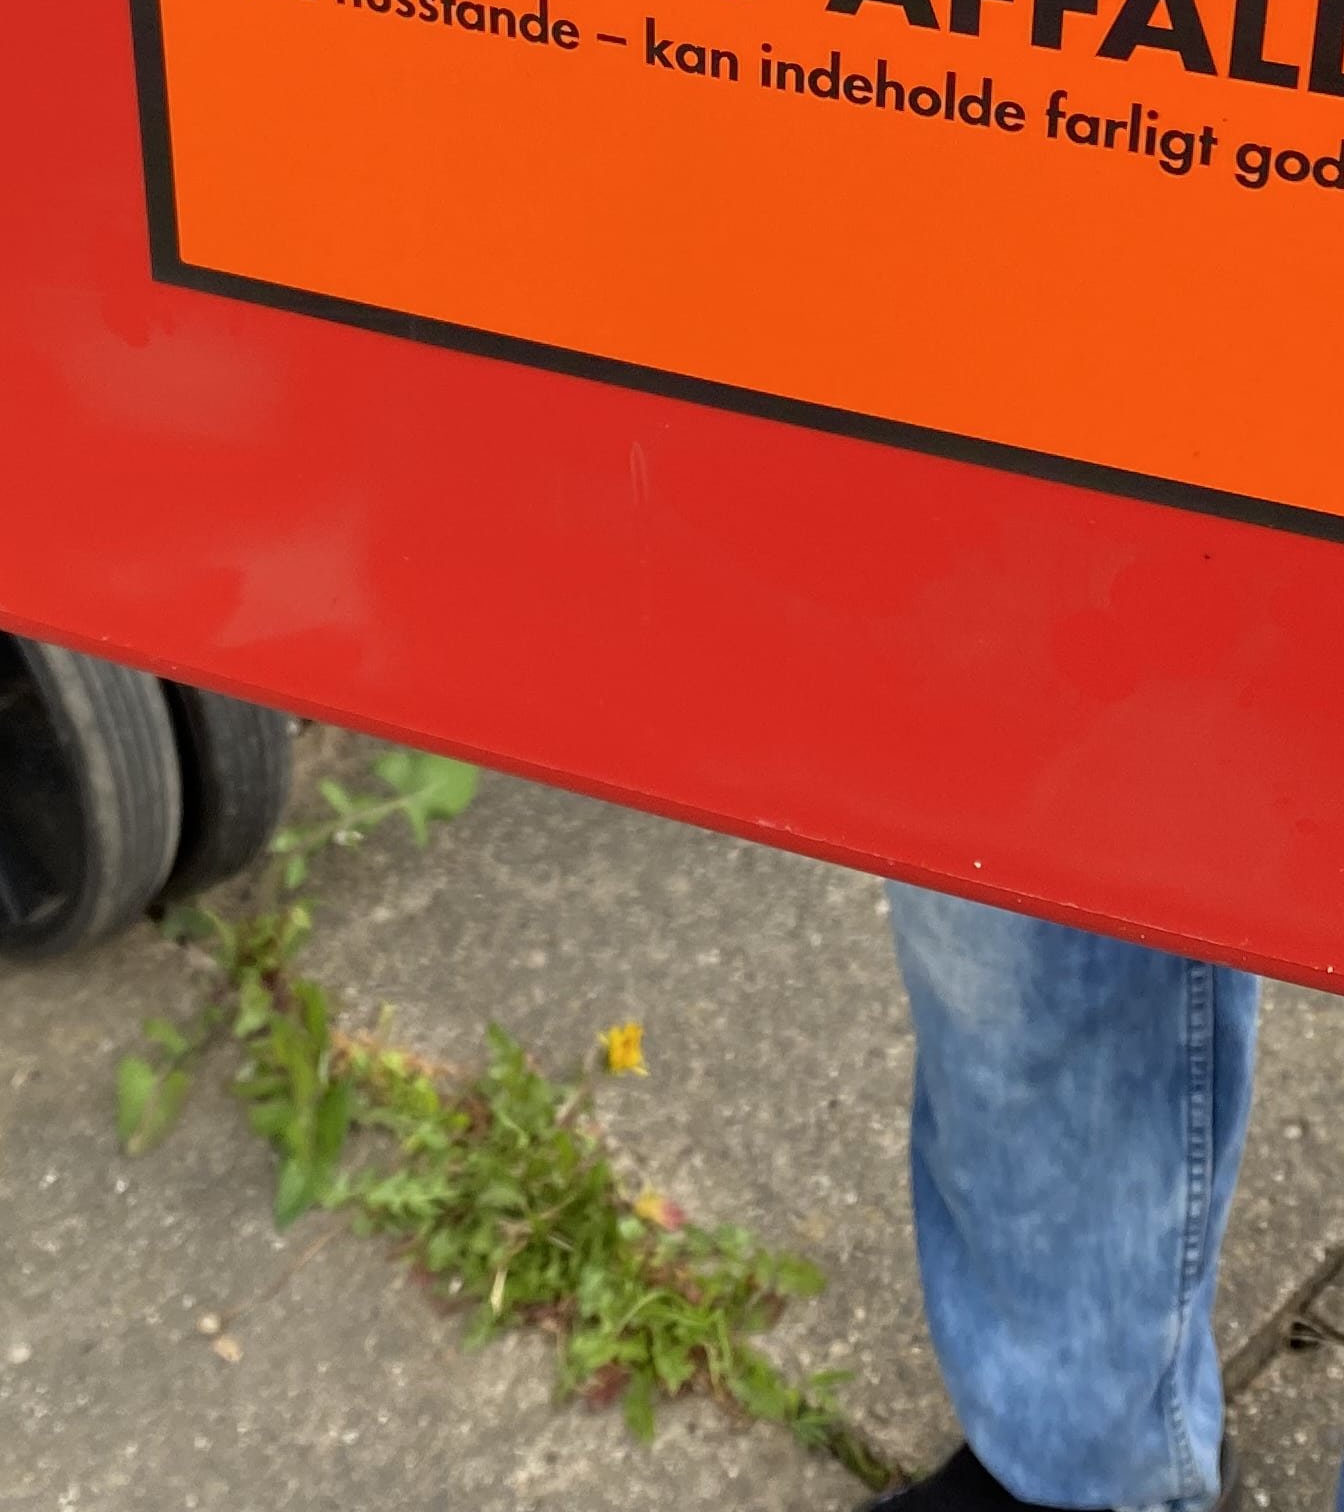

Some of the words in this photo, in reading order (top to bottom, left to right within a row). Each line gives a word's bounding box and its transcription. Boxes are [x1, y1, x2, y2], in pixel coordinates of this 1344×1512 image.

[645, 17, 739, 82] kan
[759, 42, 1026, 133] indeholde
[1045, 89, 1219, 177] farligt
